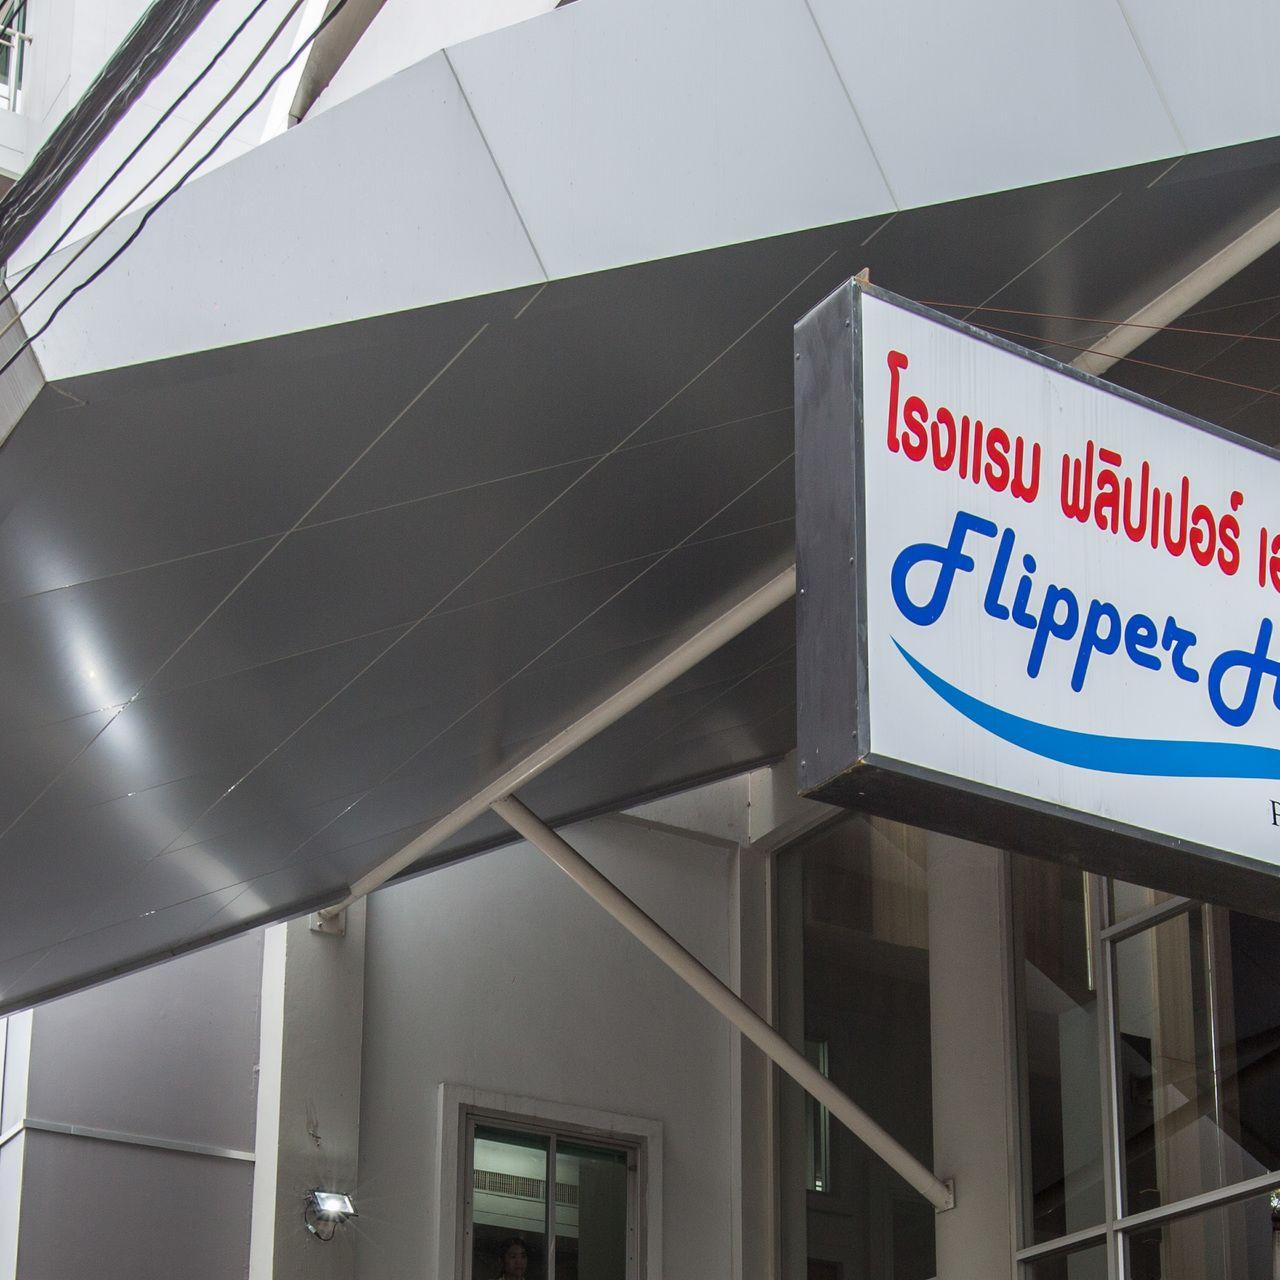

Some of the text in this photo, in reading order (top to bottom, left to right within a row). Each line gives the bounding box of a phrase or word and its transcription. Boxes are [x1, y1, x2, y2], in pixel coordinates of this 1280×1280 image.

[887, 350, 1041, 504] โรงแรม
[1060, 439, 1244, 576] ฟลิปเปอร์
[890, 511, 1200, 693] Flipper
